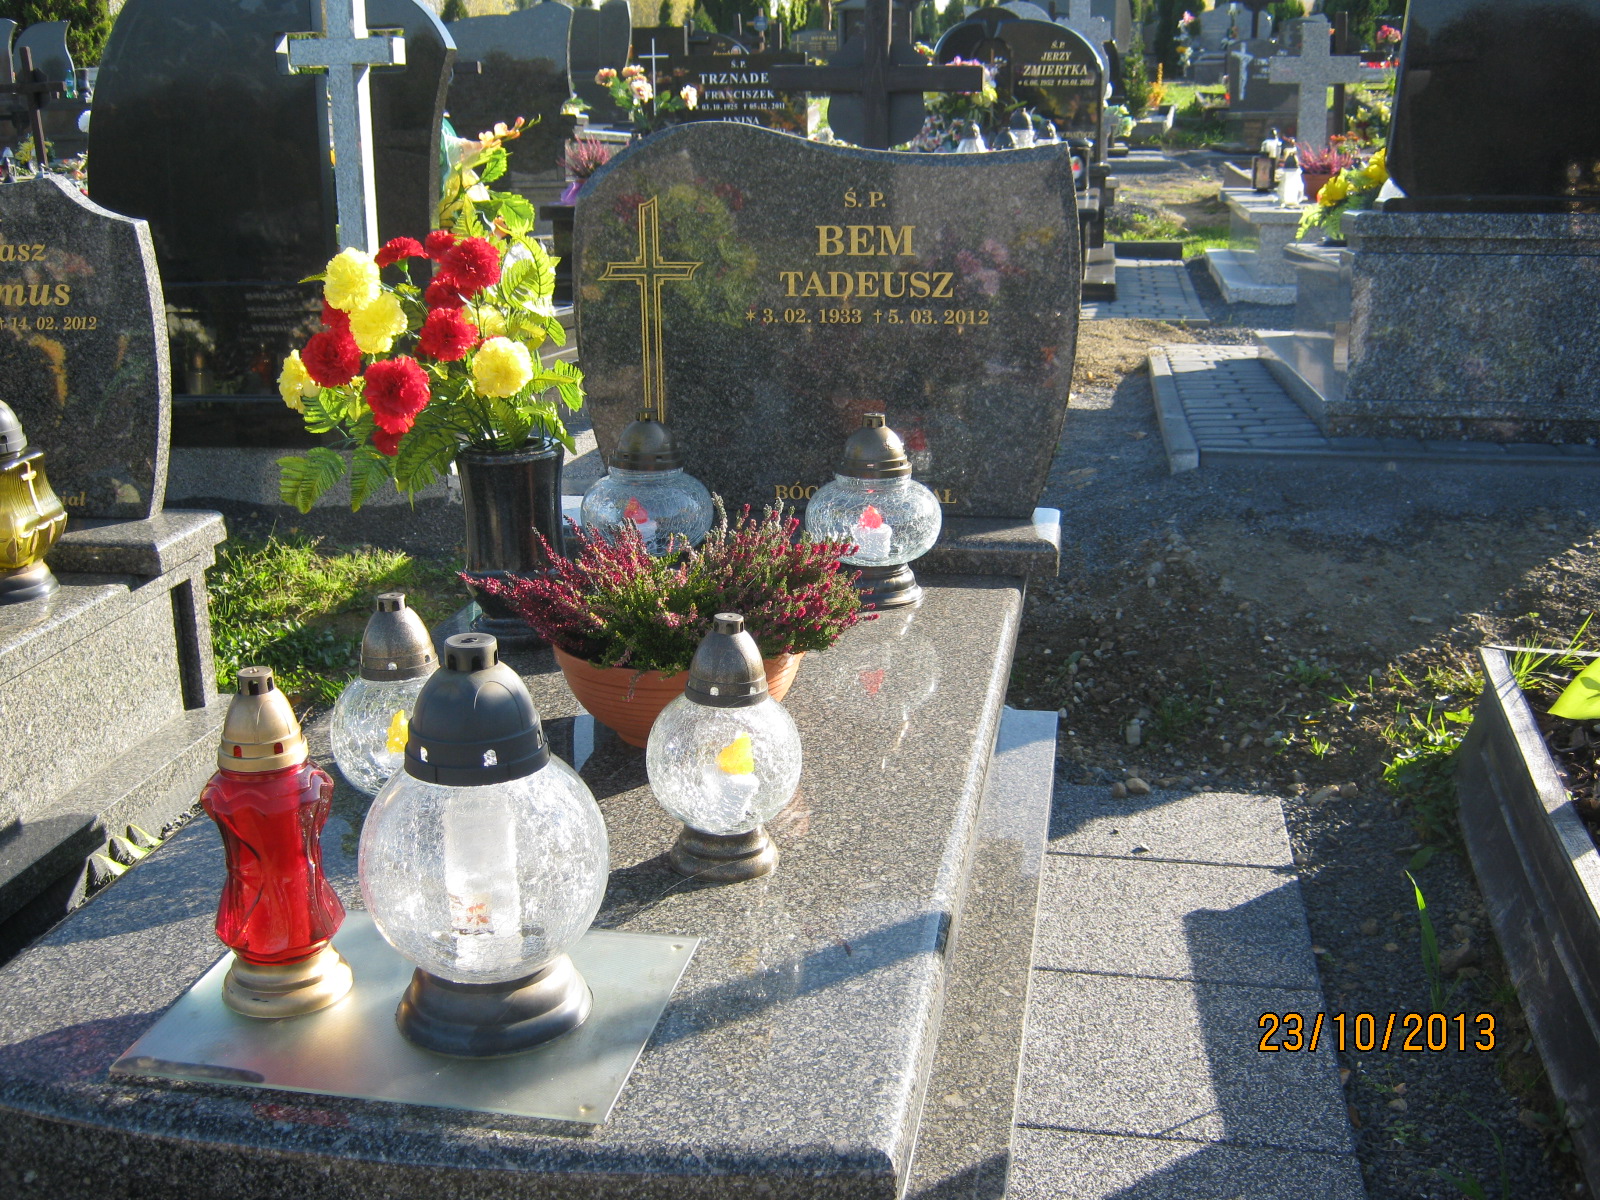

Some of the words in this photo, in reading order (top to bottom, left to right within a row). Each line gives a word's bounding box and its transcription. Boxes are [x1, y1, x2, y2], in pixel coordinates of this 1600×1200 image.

[1041, 52, 1072, 61] JERZY
[1023, 64, 1088, 76] ZMIERTKA
[704, 89, 775, 100] FRANCISZEK
[815, 225, 916, 256] BEM
[780, 271, 954, 298] TADEUSZ
[63, 316, 97, 330] 2012
[819, 308, 862, 324] 1933
[943, 309, 989, 325] 2012
